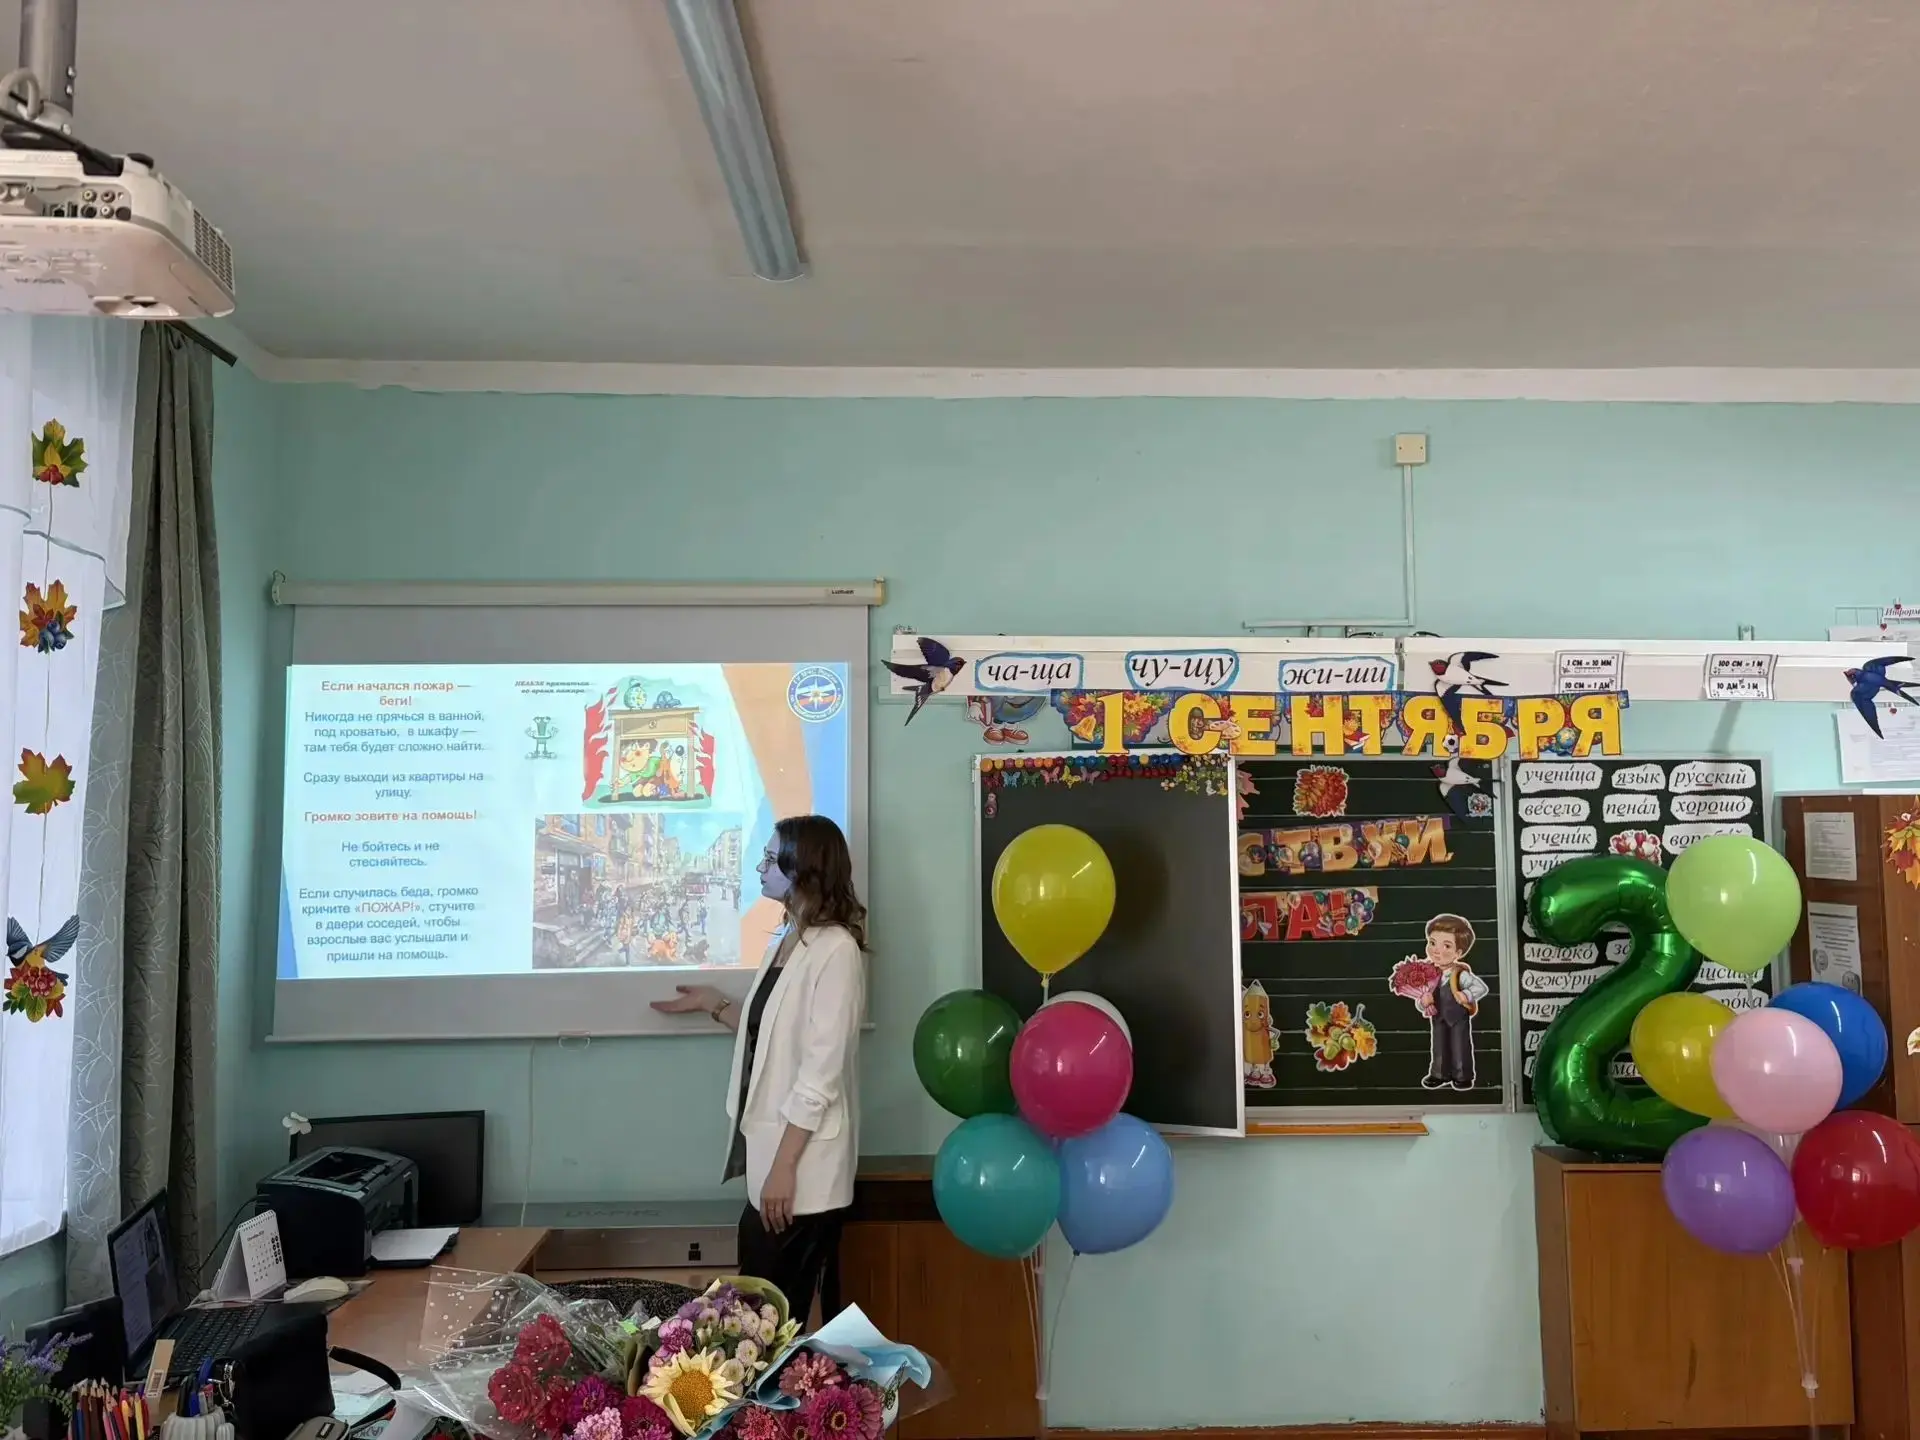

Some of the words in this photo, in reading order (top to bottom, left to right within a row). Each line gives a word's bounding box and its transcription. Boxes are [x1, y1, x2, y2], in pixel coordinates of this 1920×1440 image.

[987, 660, 1072, 686] ча-ща
[1131, 655, 1233, 687] чу-щу
[1284, 664, 1387, 686] жи-ши
[321, 681, 354, 691] Если
[357, 682, 410, 692] начался
[413, 682, 454, 693] пожар
[379, 695, 412, 706] беги!
[305, 711, 354, 723] Никогда
[358, 713, 372, 722] не
[376, 712, 424, 724] прячься
[428, 712, 436, 721] в
[438, 710, 486, 722] ванной,
[314, 728, 336, 738] под
[340, 728, 400, 738] кроватью,
[408, 728, 414, 736] в
[418, 726, 459, 738] шкафу
[1096, 691, 1130, 755] 1
[1168, 691, 1623, 760] СЕНТЯБРЯ
[304, 744, 326, 752] там
[330, 742, 358, 752] тебя
[360, 742, 395, 754] будет
[399, 742, 443, 752] сложно
[446, 741, 485, 752] найти.
[304, 772, 340, 785] Сразу
[344, 774, 389, 784] выходи
[392, 774, 405, 782] из
[409, 772, 466, 784] квартиры
[469, 773, 484, 782] на
[375, 788, 412, 800] улицу.
[304, 812, 352, 824] Громко
[354, 812, 399, 821] зовите
[402, 812, 418, 820] на
[422, 810, 478, 822] помощь!
[341, 842, 358, 852] Не
[362, 840, 411, 852] бойтесь
[414, 842, 422, 851] и
[425, 842, 440, 851] не
[1238, 817, 1449, 877] СТВУЙ
[349, 856, 428, 868] стесняйтесь.
[299, 888, 330, 899] Если
[333, 888, 397, 900] случилась
[400, 886, 433, 898] беда,
[437, 888, 478, 898] громко
[302, 904, 350, 915] кричите
[428, 902, 476, 913] стучите
[315, 921, 322, 930] в
[325, 920, 364, 932] двери
[366, 918, 420, 930] соседей,
[424, 916, 461, 926] чтобы
[307, 935, 367, 946] взрослые
[370, 934, 392, 944] вас
[394, 934, 458, 946] услышали
[460, 933, 468, 942] и
[326, 952, 376, 962] пришли
[378, 952, 393, 960] на
[396, 950, 448, 962] помощь.
